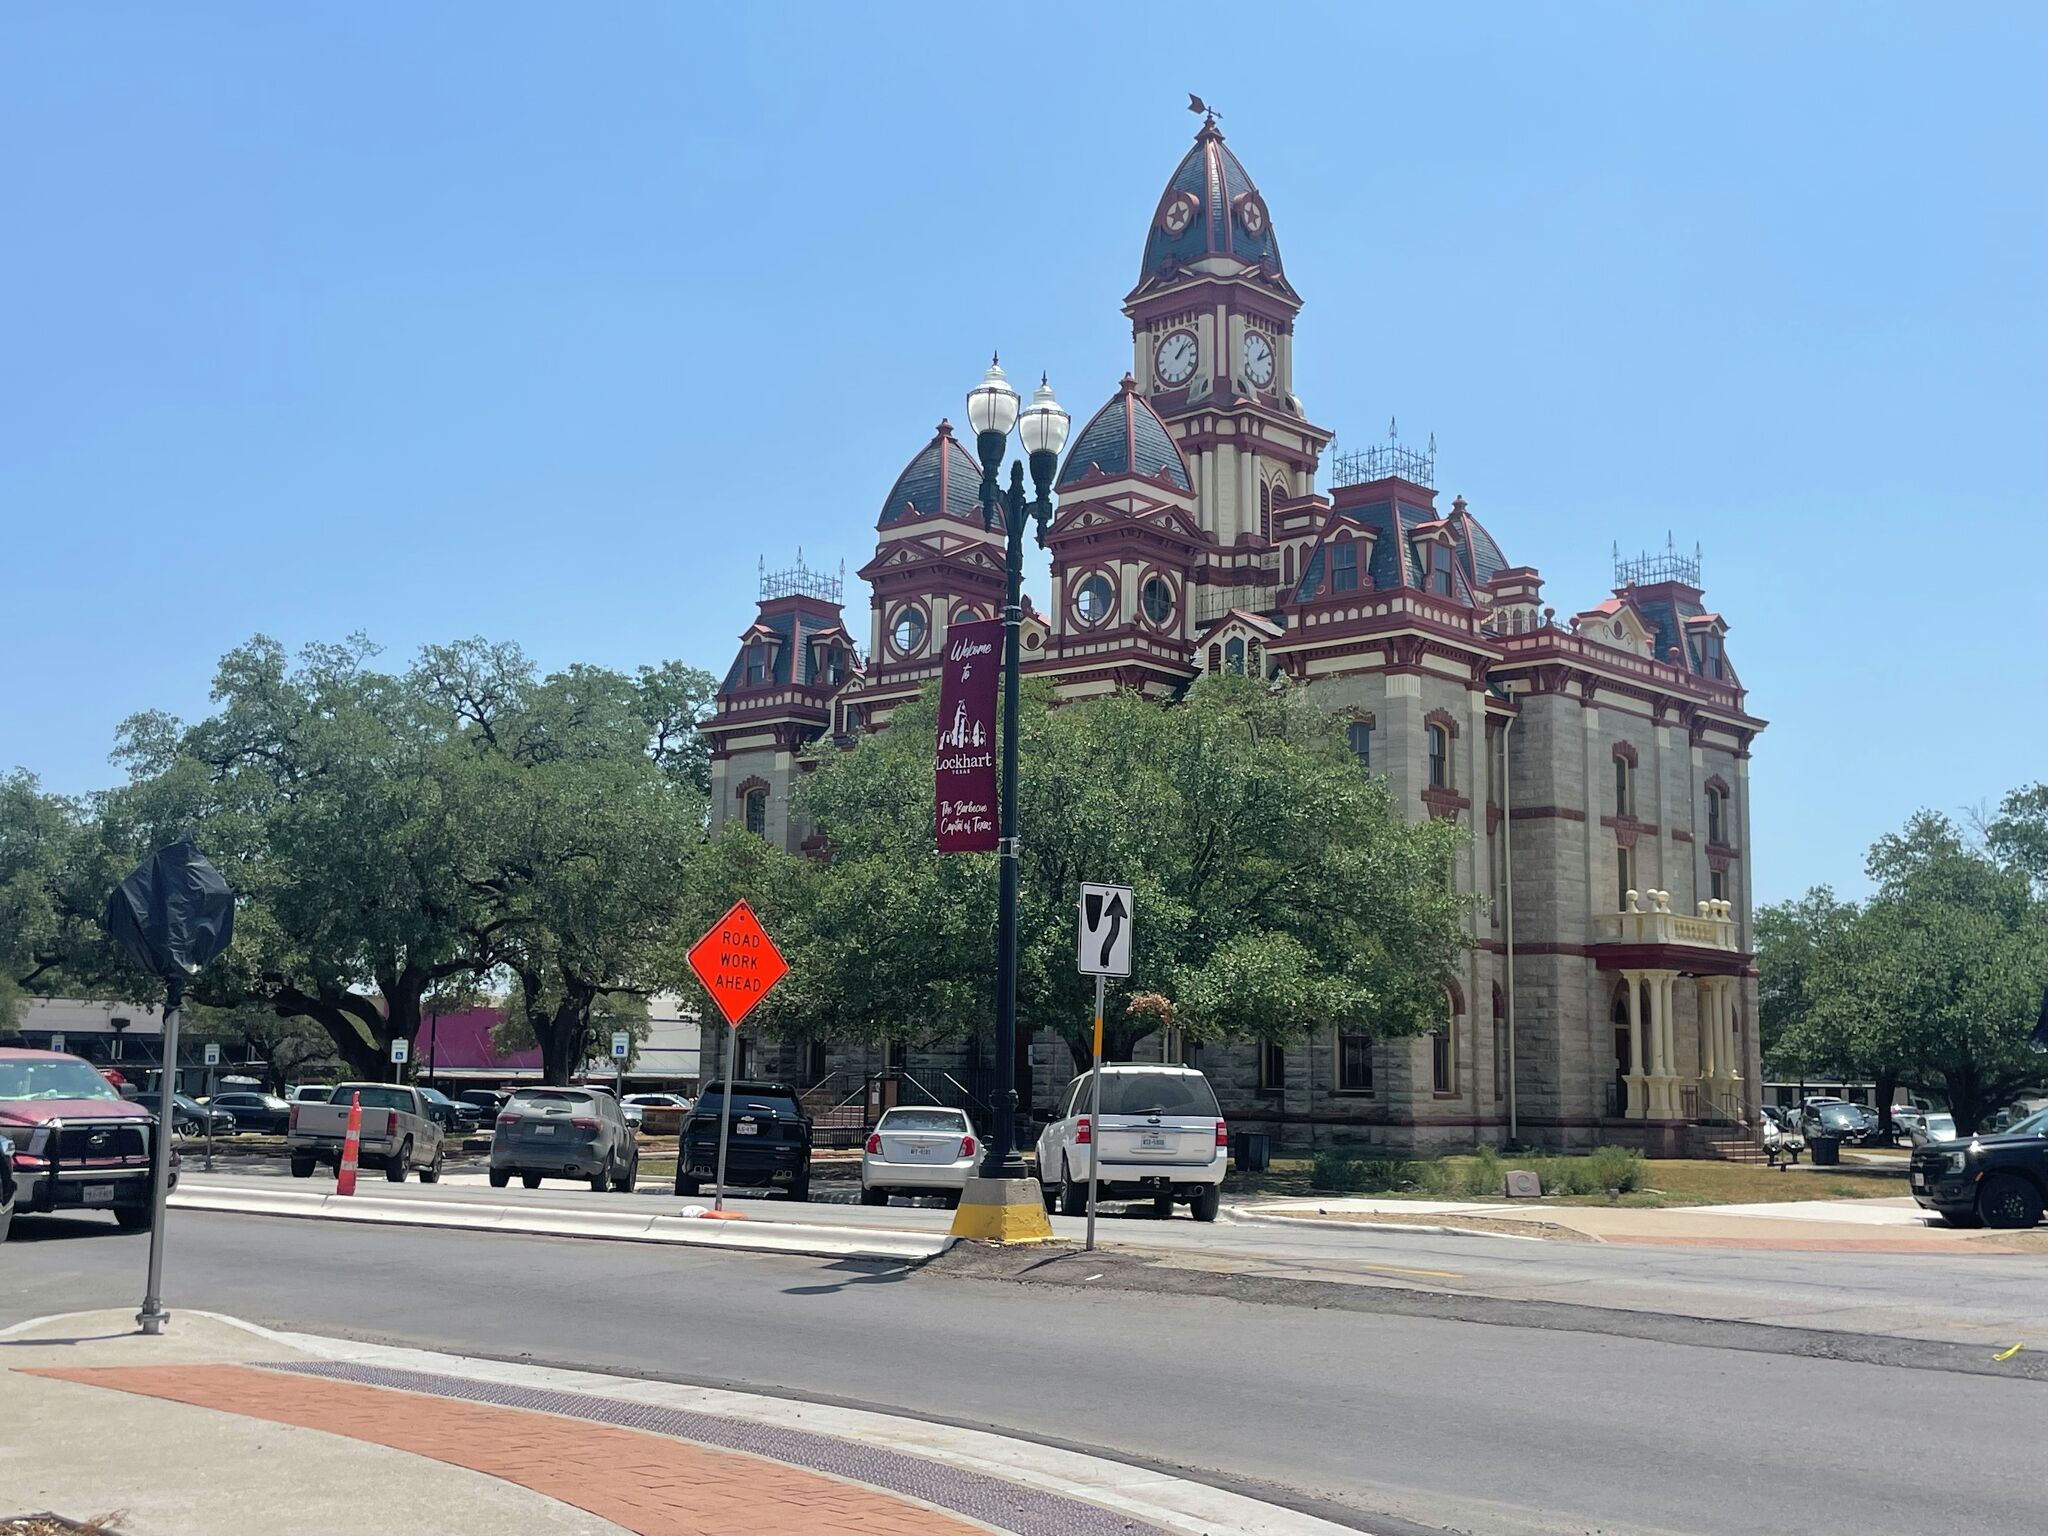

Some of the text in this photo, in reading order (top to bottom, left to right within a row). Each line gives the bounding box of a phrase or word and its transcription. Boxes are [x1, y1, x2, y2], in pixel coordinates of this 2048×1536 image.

[950, 637, 992, 662] Welcome
[961, 662, 972, 683] to
[935, 752, 992, 771] Lockhart
[940, 800, 988, 817] The Barbecue
[941, 816, 992, 836] Capital of Texas
[722, 931, 760, 948] ROAD
[720, 953, 758, 970] WORK
[715, 974, 761, 992] AHEAD
